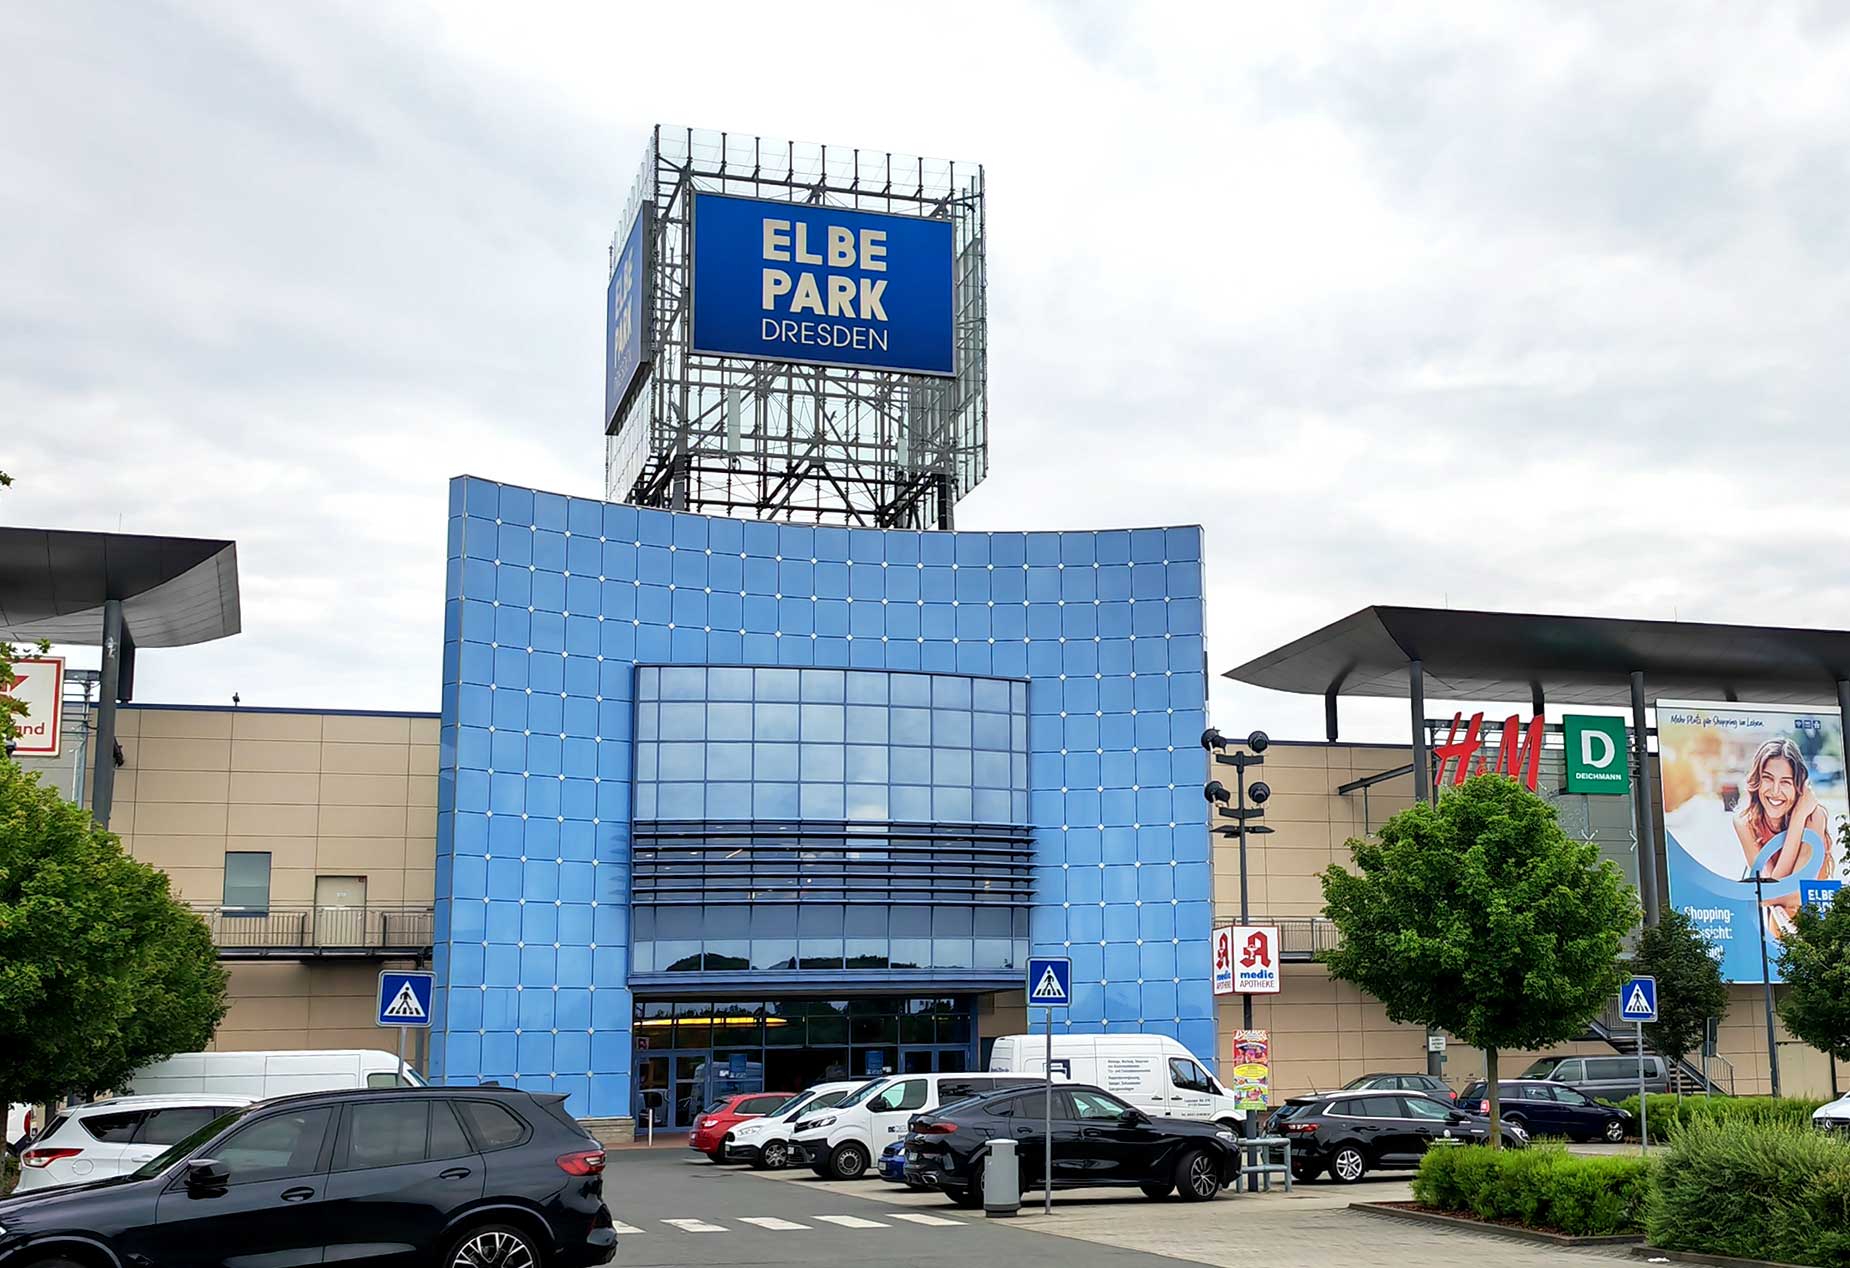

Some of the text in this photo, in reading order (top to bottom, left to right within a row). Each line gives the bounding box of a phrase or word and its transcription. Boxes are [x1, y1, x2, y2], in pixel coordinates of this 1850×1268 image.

[763, 218, 887, 272] ELBE
[762, 268, 888, 321] PARK
[762, 318, 888, 351] DRESDEN
[1432, 711, 1545, 793] H&M
[1576, 773, 1622, 782] DEICHMANN
[1808, 889, 1835, 901] ELBE
[1684, 906, 1735, 923] Shopping-
[1240, 969, 1274, 979] medic
[1239, 980, 1275, 988] APOTHEKE
